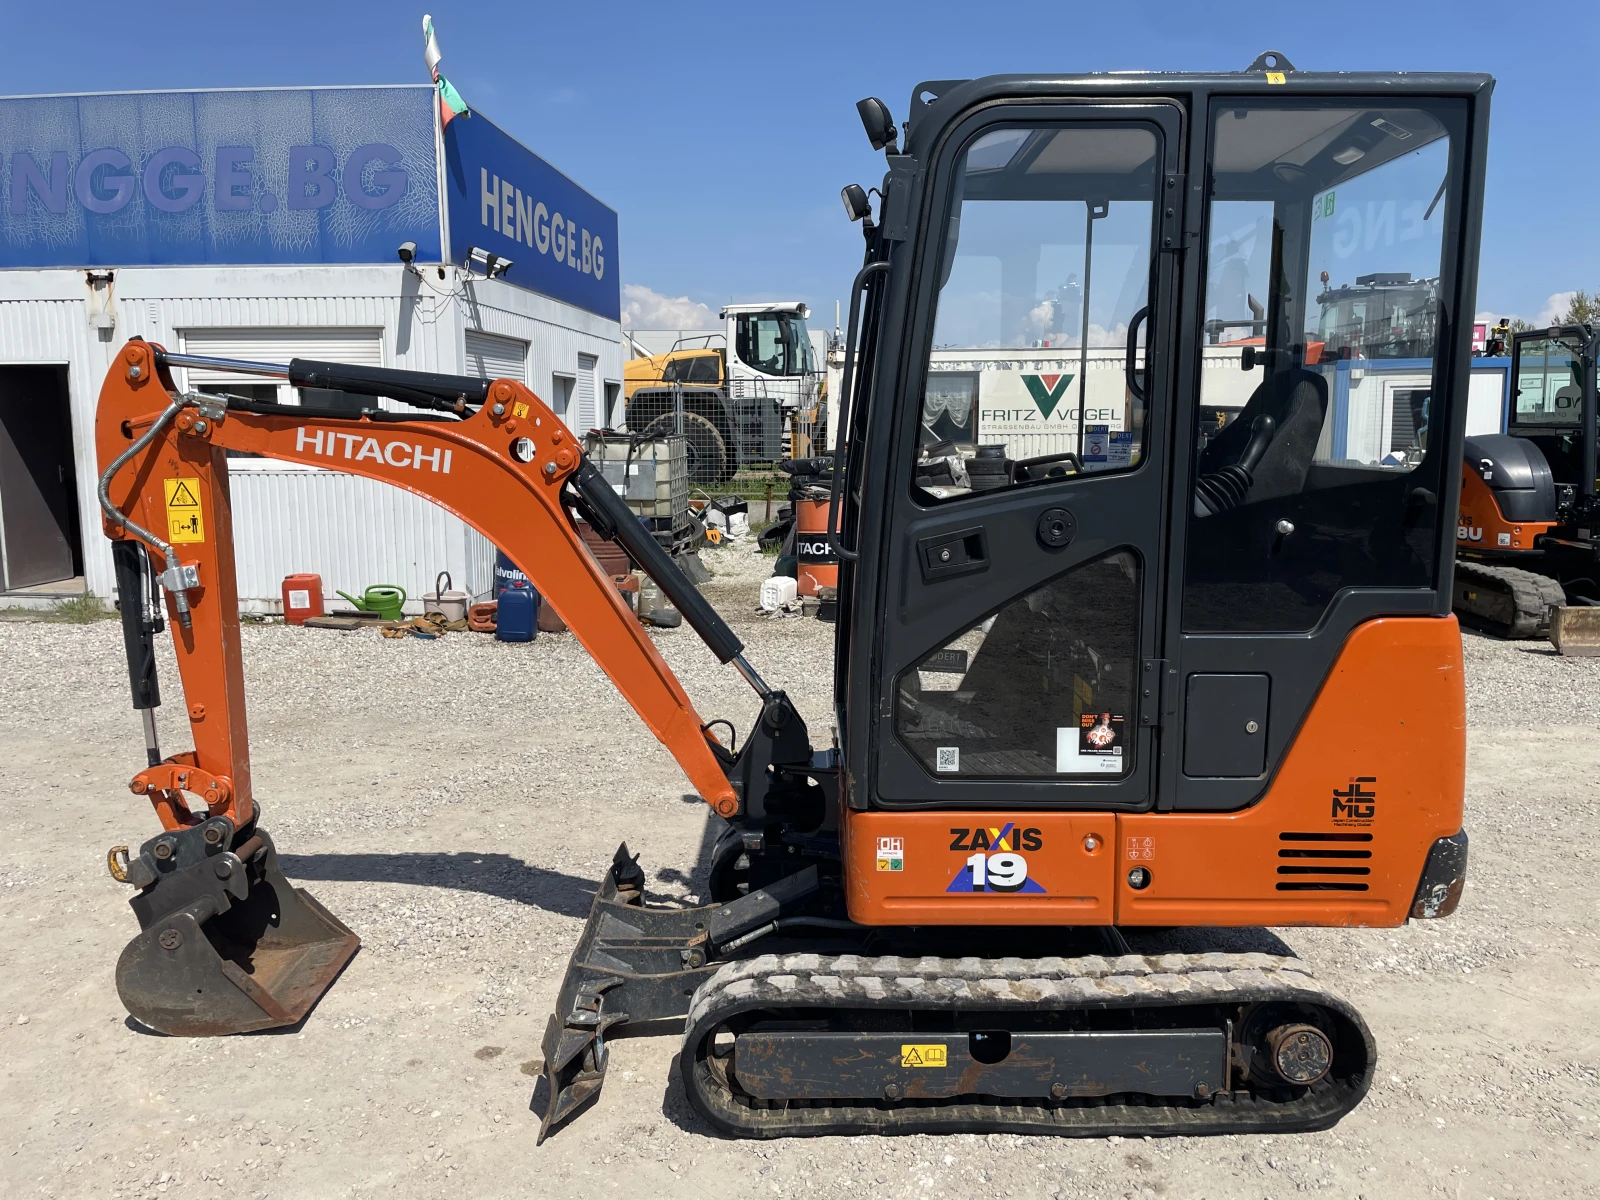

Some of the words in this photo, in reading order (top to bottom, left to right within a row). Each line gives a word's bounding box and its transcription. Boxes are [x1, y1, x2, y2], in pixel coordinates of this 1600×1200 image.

[0, 143, 408, 214] NGGE.BG
[481, 167, 604, 280] HENGGE.BG
[982, 409, 1036, 421] FRITZ
[1056, 408, 1122, 421] VOGEL
[296, 427, 453, 474] HITACHI
[495, 566, 529, 581] alvolin
[950, 822, 1042, 851] ZAXIS
[967, 852, 1028, 891] 19
